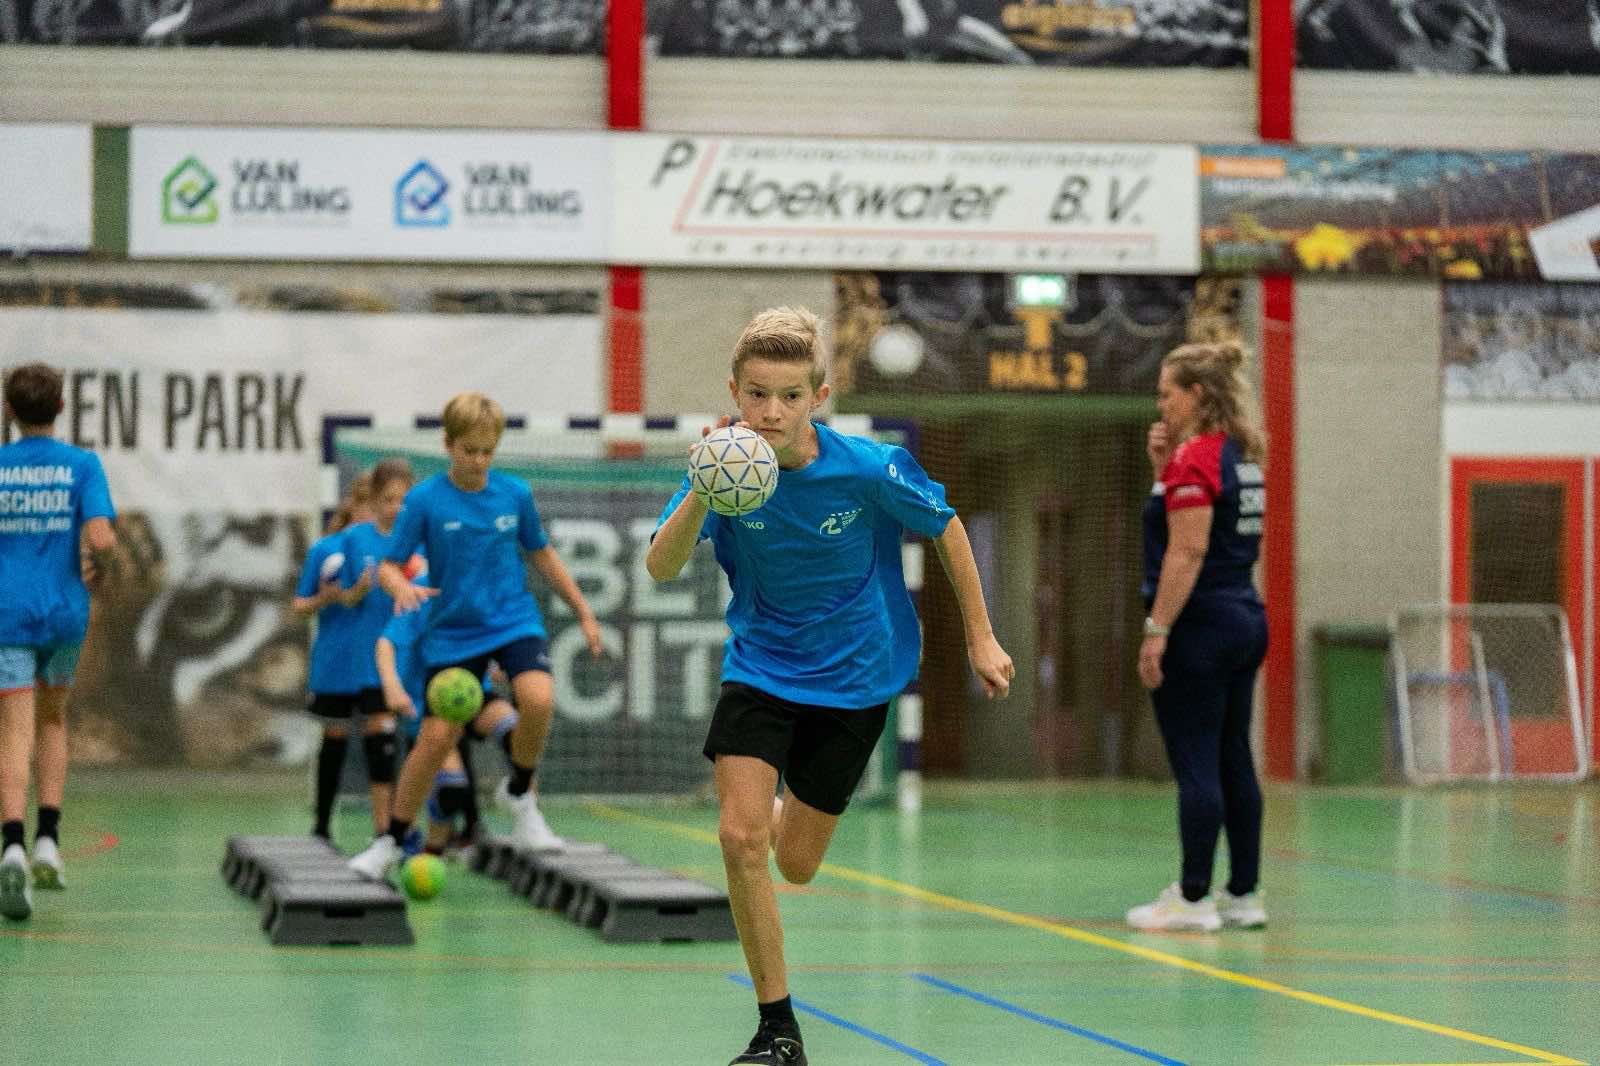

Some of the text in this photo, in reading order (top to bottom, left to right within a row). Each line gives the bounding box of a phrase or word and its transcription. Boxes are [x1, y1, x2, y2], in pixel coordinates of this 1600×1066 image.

[231, 158, 299, 183] VAN
[463, 162, 530, 186] VAN
[651, 139, 696, 187] P
[702, 169, 1008, 220] Hoekwater
[164, 370, 305, 450] PARK
[0, 489, 72, 513] SCHOOL
[551, 518, 734, 616] BE
